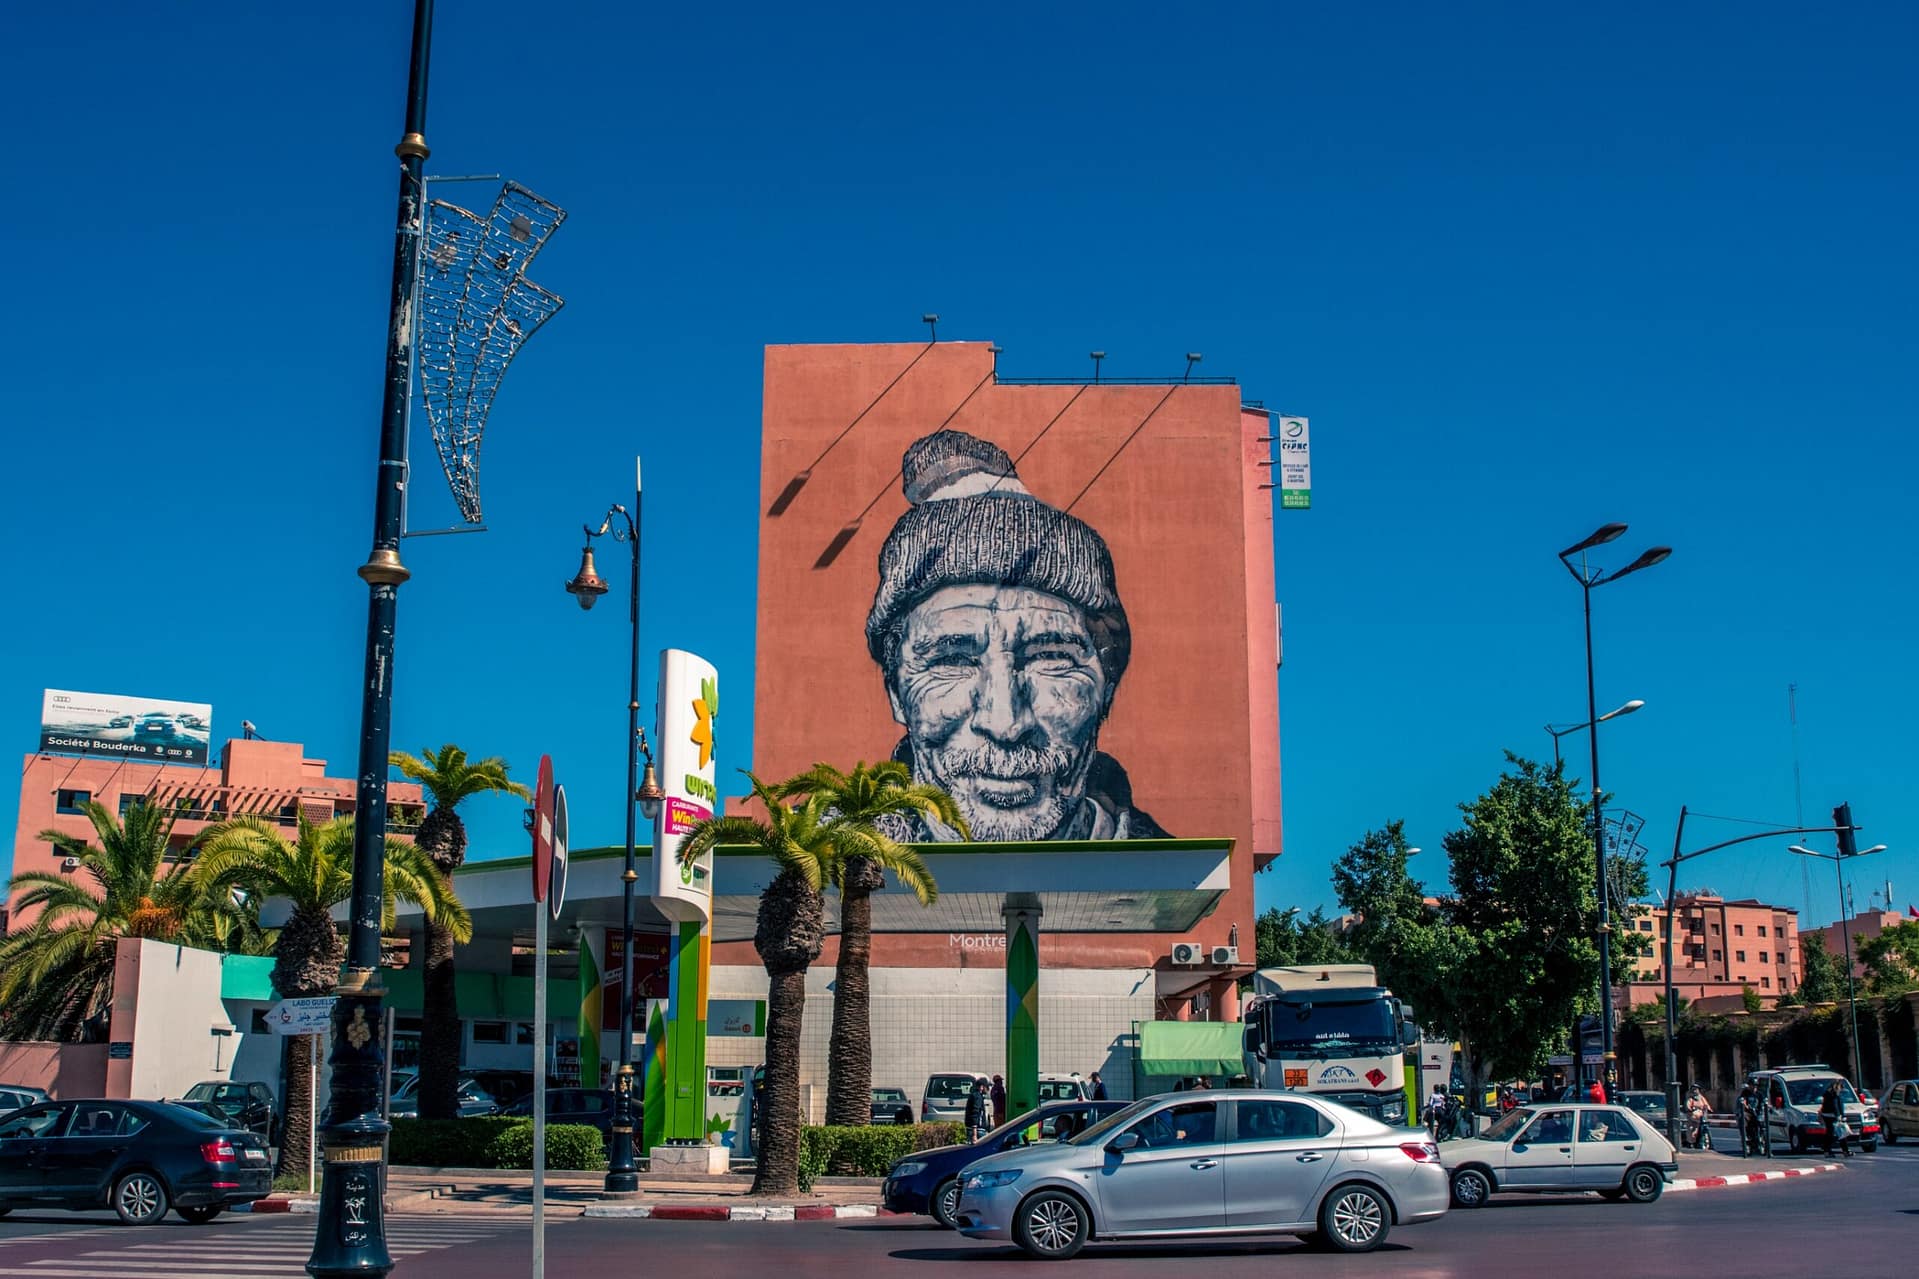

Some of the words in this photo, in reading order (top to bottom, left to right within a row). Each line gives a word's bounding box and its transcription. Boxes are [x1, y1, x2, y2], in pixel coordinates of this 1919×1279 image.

[48, 736, 90, 748] Société
[93, 740, 146, 753] Bouderka
[345, 1182, 366, 1192] مدينة
[345, 1231, 368, 1241] مراكش
